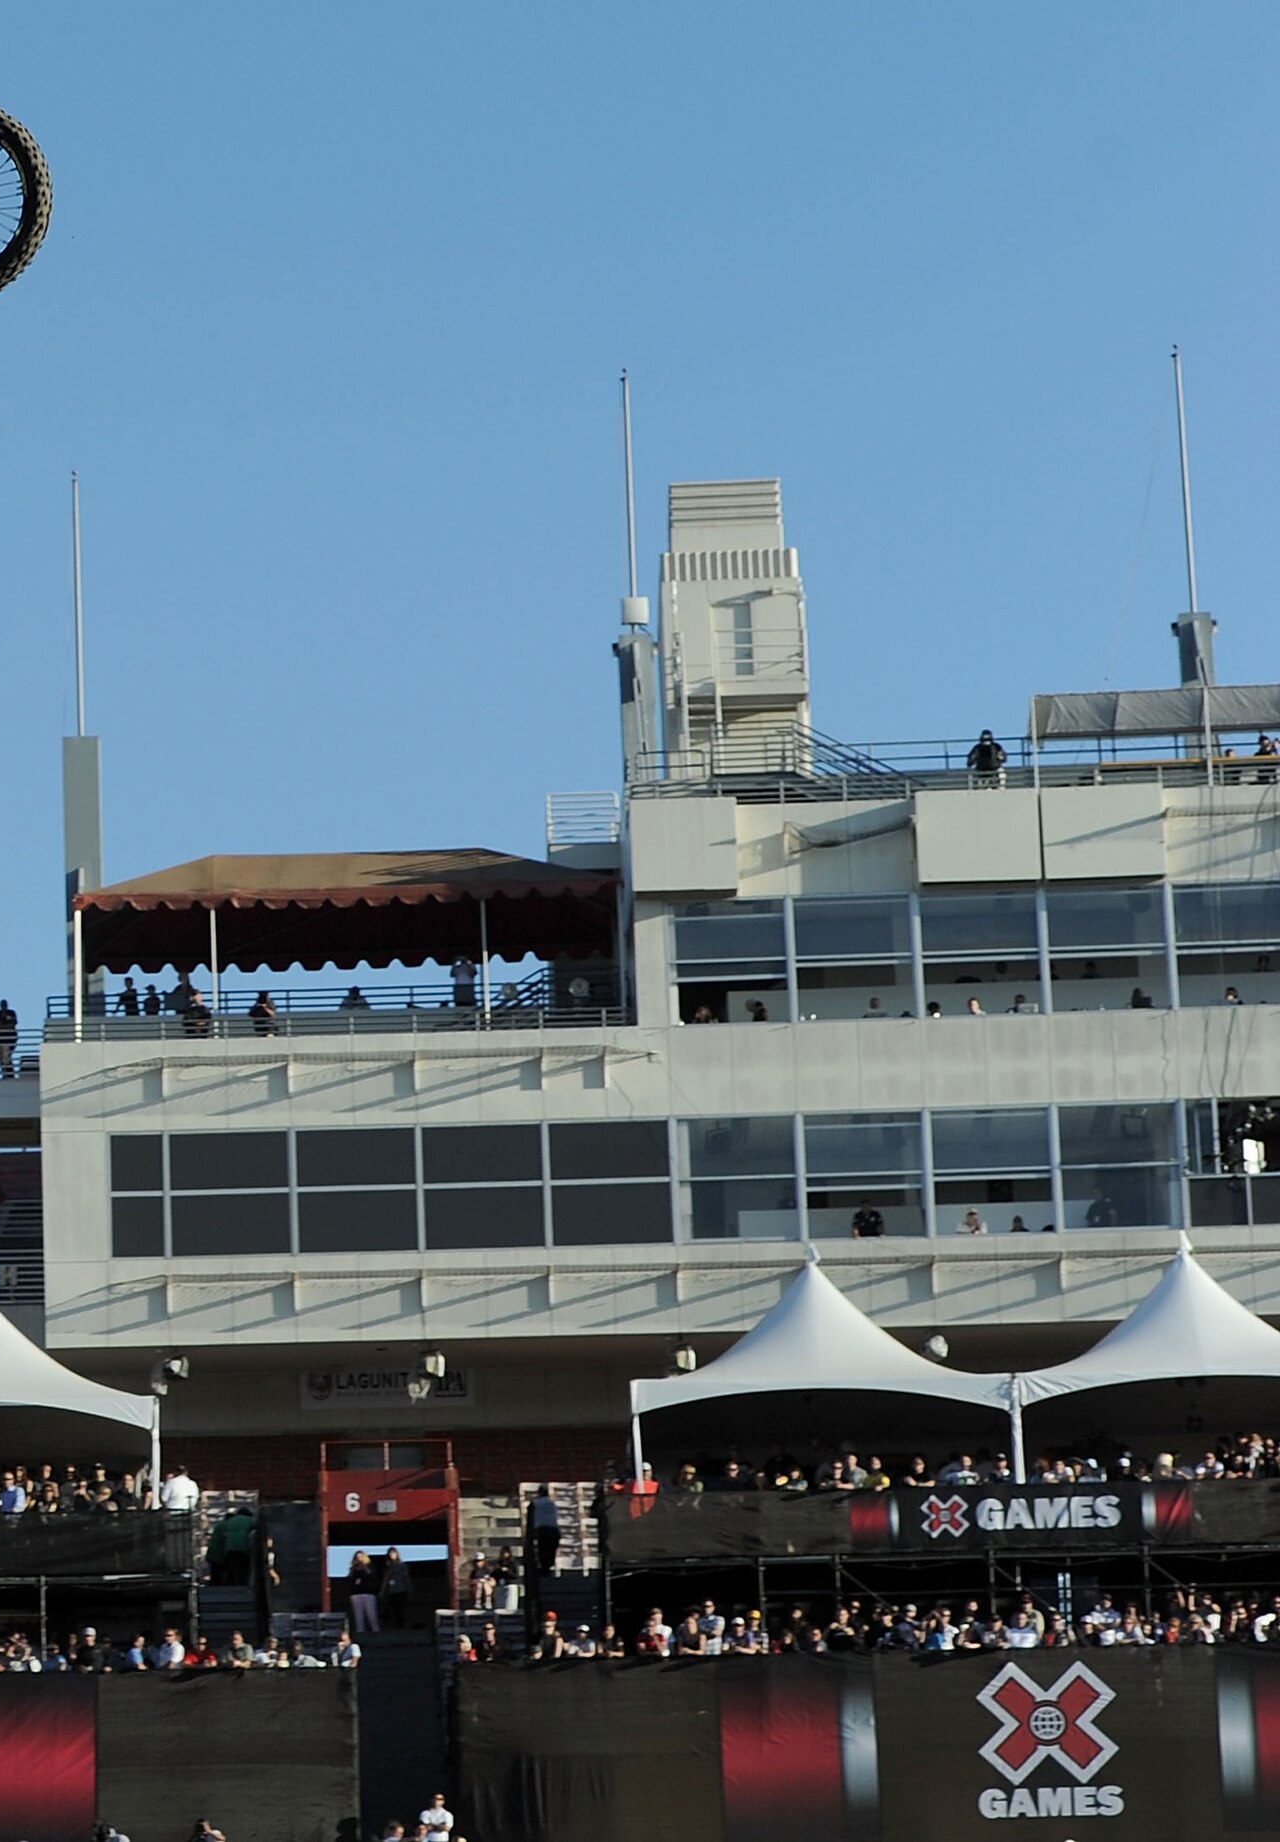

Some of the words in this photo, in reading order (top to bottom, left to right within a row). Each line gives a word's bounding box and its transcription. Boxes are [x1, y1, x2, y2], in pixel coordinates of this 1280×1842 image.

[335, 1371, 410, 1390] LAGUNIT
[345, 1492, 361, 1512] 6
[976, 1494, 1122, 1531] GAMES
[977, 1784, 1125, 1820] GAMES
